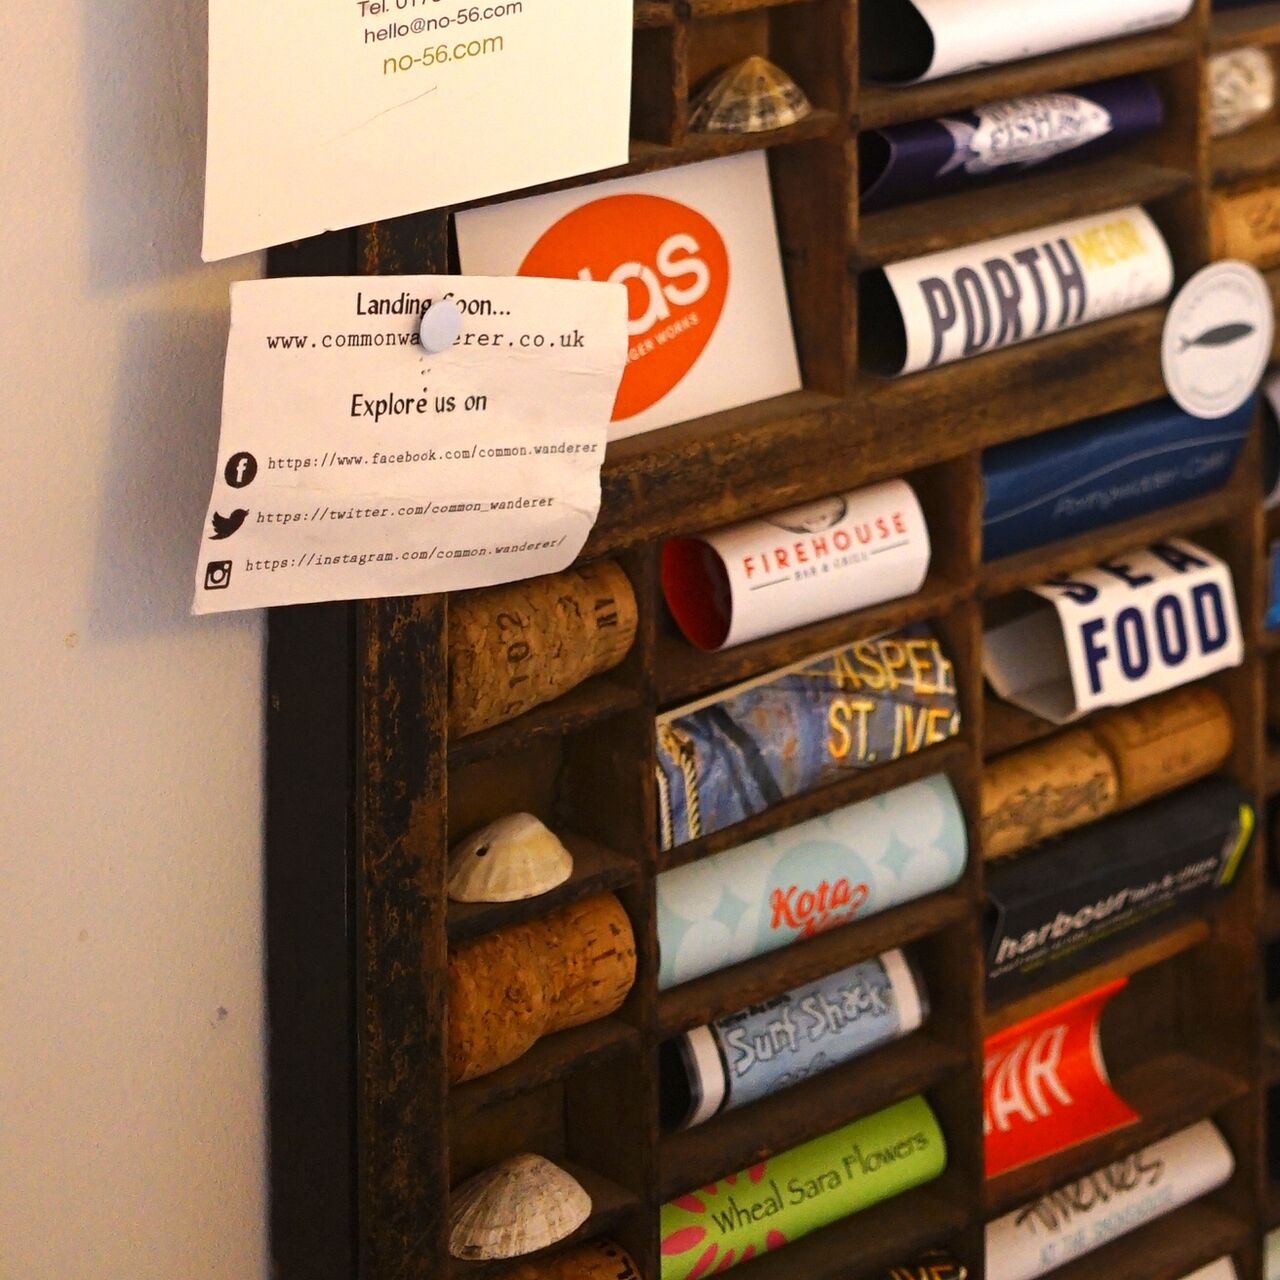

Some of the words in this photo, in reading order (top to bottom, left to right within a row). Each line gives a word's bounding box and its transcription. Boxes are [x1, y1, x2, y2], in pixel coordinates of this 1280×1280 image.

[357, 0, 390, 18] Tel.
[364, 0, 523, 45] hello@no-56.com
[383, 33, 505, 76] no-56.com
[356, 292, 432, 319] Landing
[442, 292, 511, 317] oon...
[578, 232, 711, 336] as
[918, 236, 1089, 368] PORTH
[266, 330, 585, 351] www.commonwarer.co.uk
[655, 311, 699, 345] WORKS
[350, 392, 428, 423] Explore
[434, 395, 456, 413] us
[464, 394, 488, 412] on
[267, 441, 598, 471] https://www.facebook.com/common.wanderer
[257, 495, 555, 525] https://twitter.com/common_wanderer
[245, 535, 568, 573] https://instagram.com/common.wanderer/
[743, 511, 908, 580] FIREHOUSE
[1080, 581, 1229, 695] FOOD
[827, 698, 877, 762] ST.
[769, 877, 869, 930] Kota
[725, 1009, 800, 1079] Surf
[982, 1024, 1074, 1136] AR
[711, 1179, 784, 1235] Wheal
[787, 1168, 842, 1206] Sara
[841, 1131, 929, 1180] Flowers
